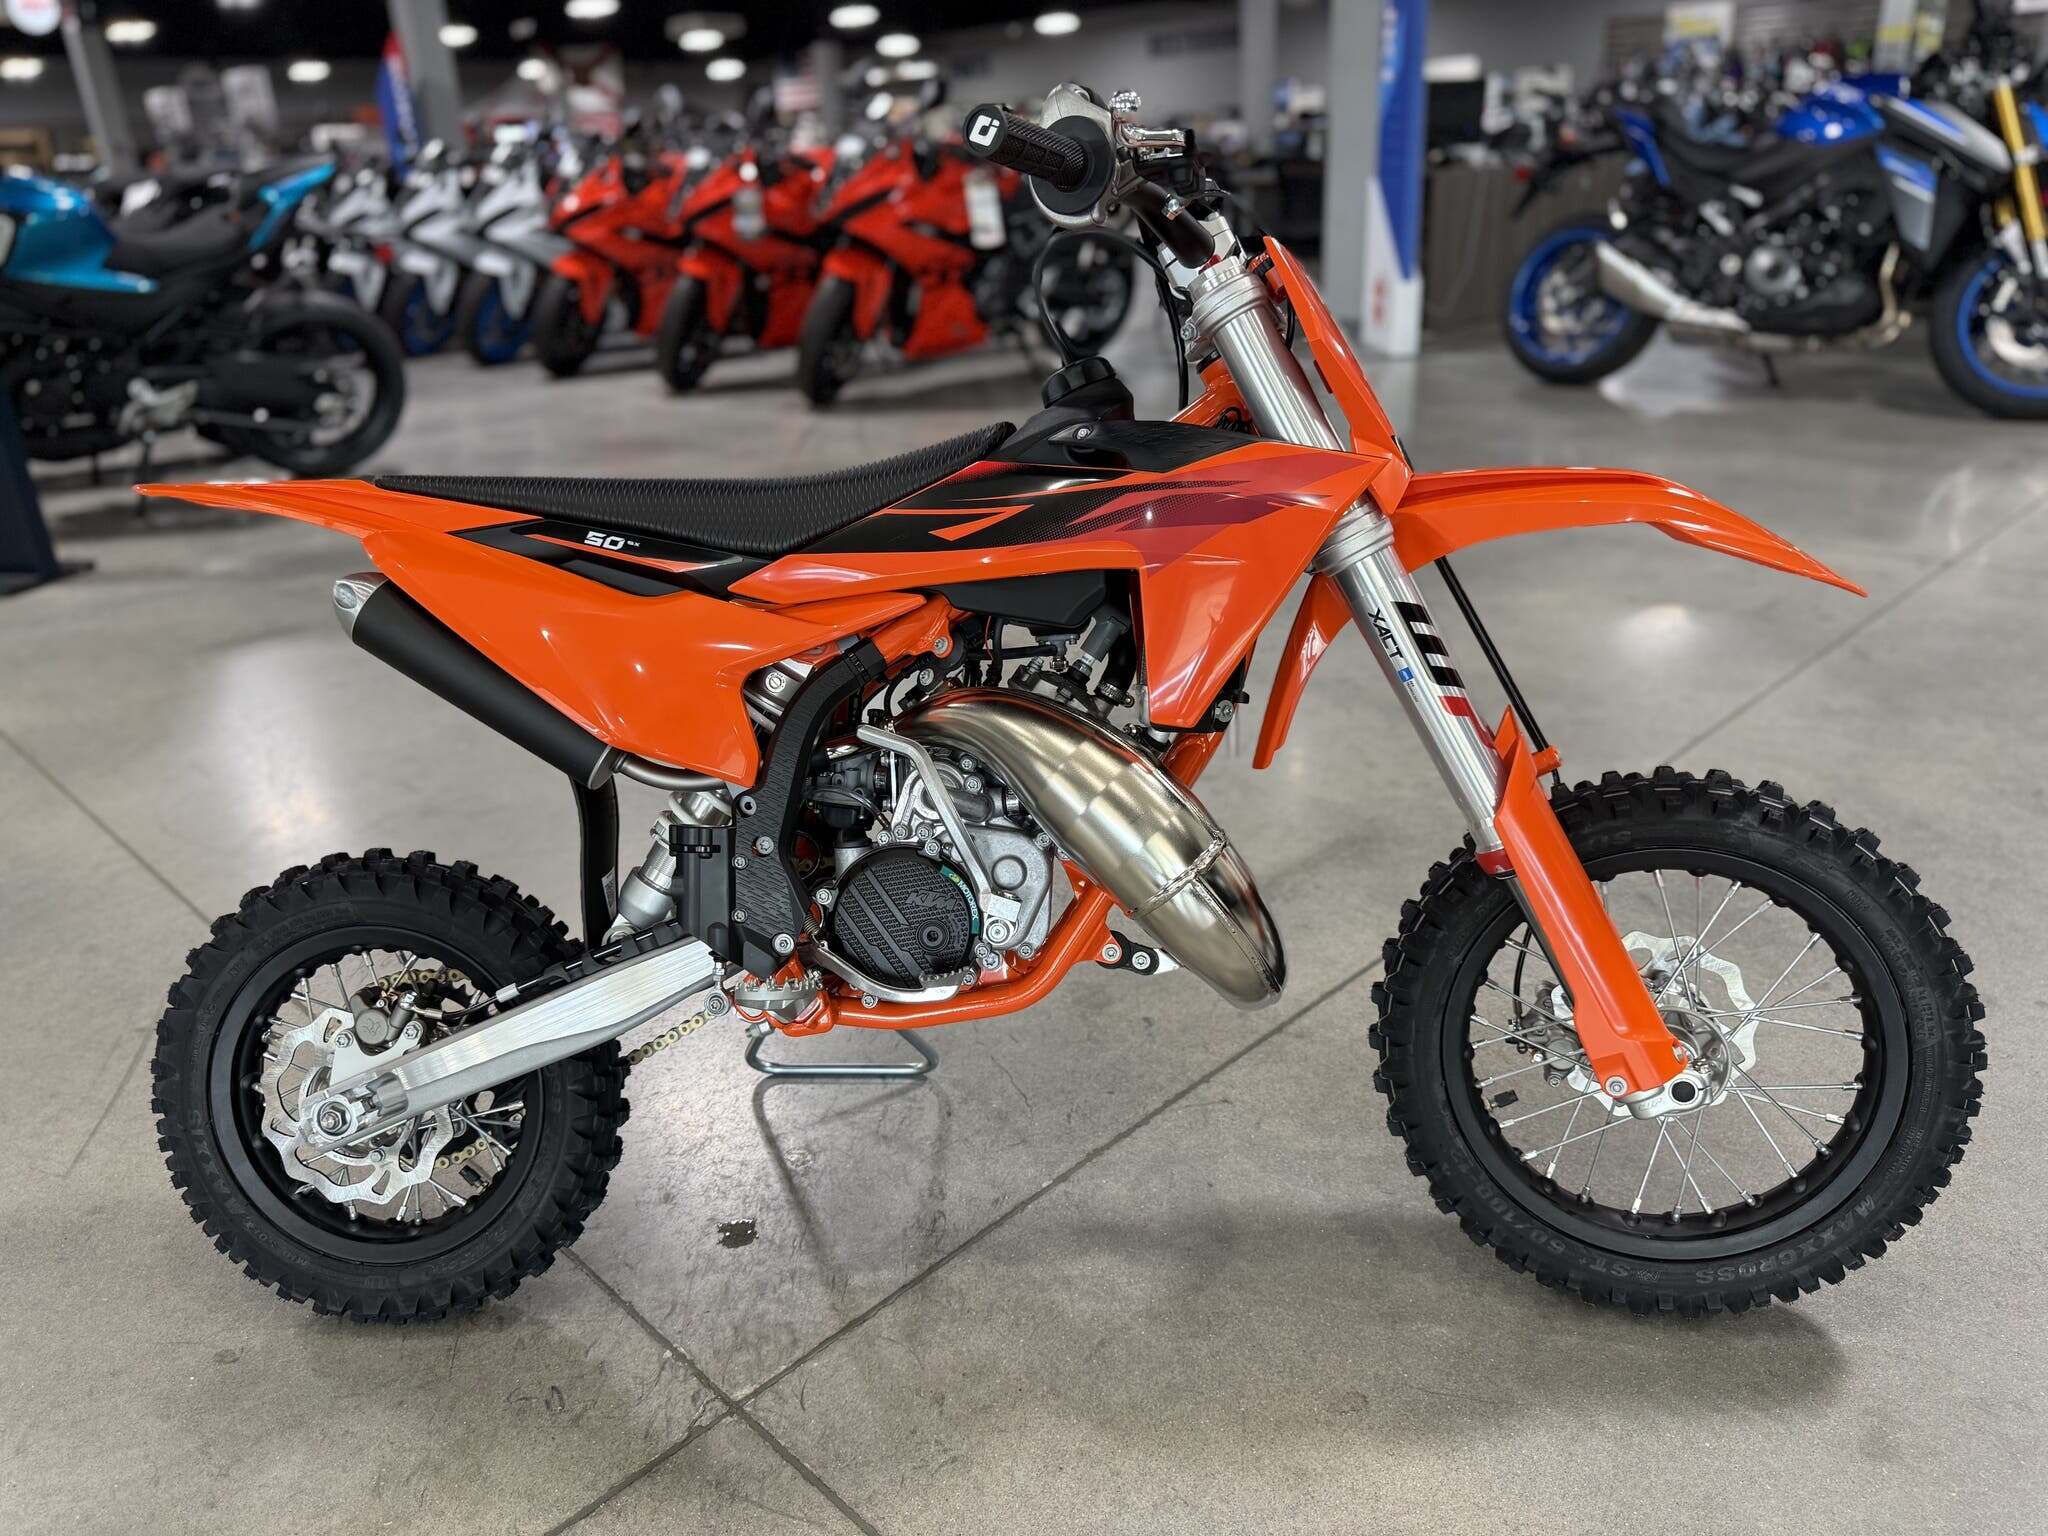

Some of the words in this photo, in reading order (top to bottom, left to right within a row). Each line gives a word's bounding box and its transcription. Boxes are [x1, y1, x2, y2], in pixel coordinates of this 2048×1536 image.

[584, 531, 625, 550] 50
[1368, 608, 1404, 659] XACT
[903, 888, 957, 909] KTM
[957, 879, 979, 920] MOTOREX
[1695, 1195, 1876, 1284] MAXXCROSS
